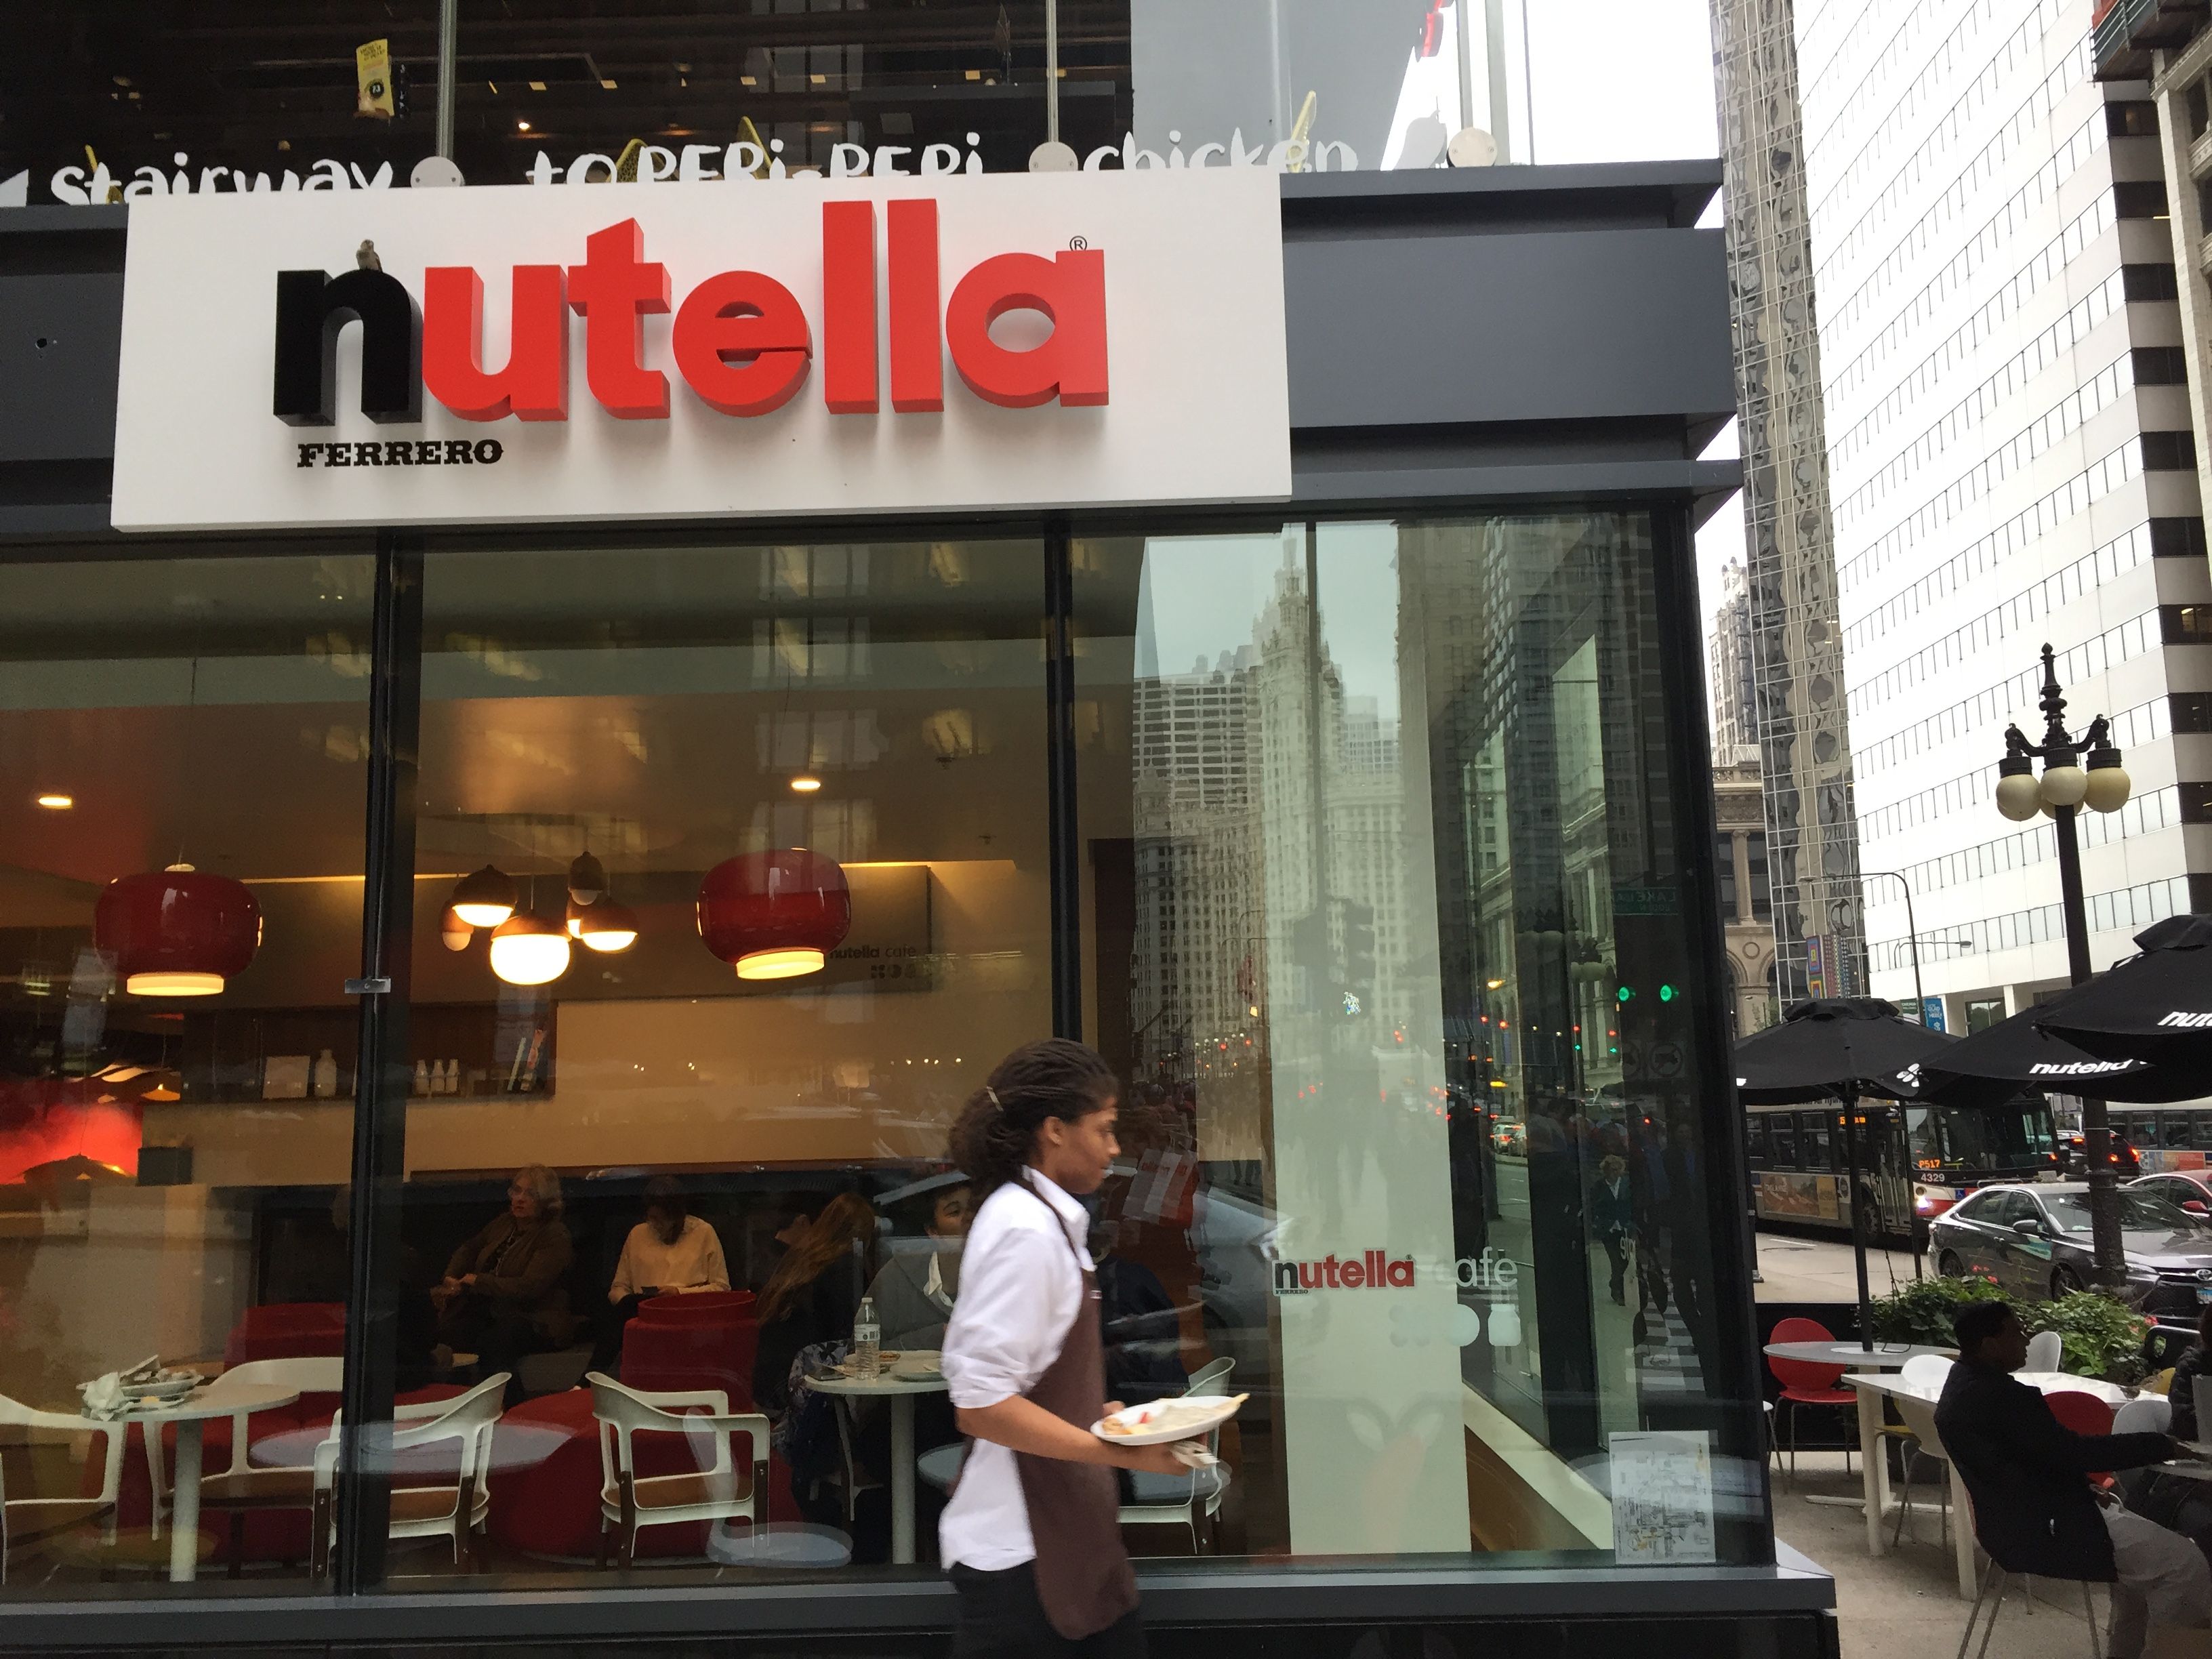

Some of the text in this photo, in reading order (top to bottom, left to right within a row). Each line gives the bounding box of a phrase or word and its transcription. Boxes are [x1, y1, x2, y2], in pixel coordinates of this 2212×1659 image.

[51, 152, 393, 205] stairway
[526, 150, 617, 184] to
[1084, 127, 1358, 173] chicken
[272, 199, 1109, 424] nutella
[297, 439, 504, 468] FERRERO
[830, 945, 880, 959] nutella
[2029, 1059, 2134, 1075] nutella
[1921, 1173, 1945, 1182] 4329
[1275, 1250, 1415, 1288] nutella
